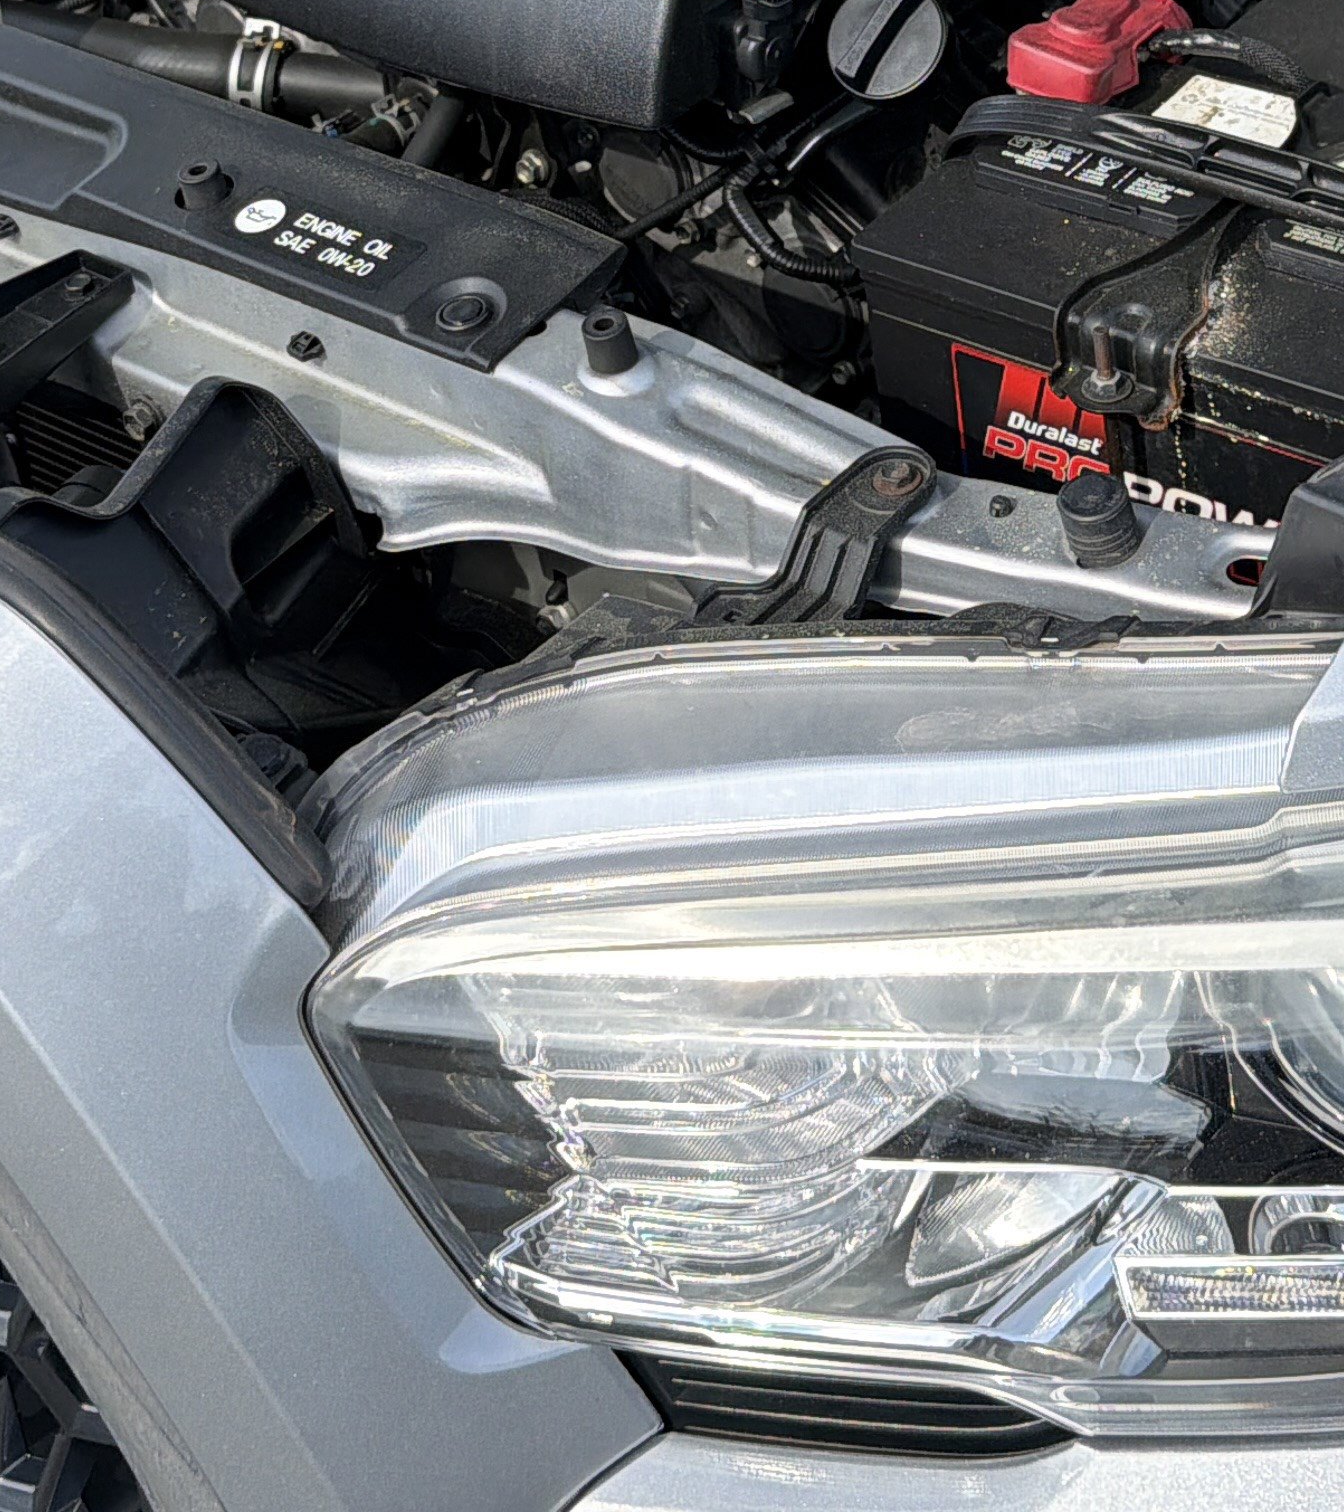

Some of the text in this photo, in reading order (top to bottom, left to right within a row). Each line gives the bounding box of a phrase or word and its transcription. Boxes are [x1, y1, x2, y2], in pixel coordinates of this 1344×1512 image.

[273, 230, 376, 277] SAE 0W-20
[293, 213, 394, 260] ENGINE OIL
[1007, 410, 1103, 456] Duralast
